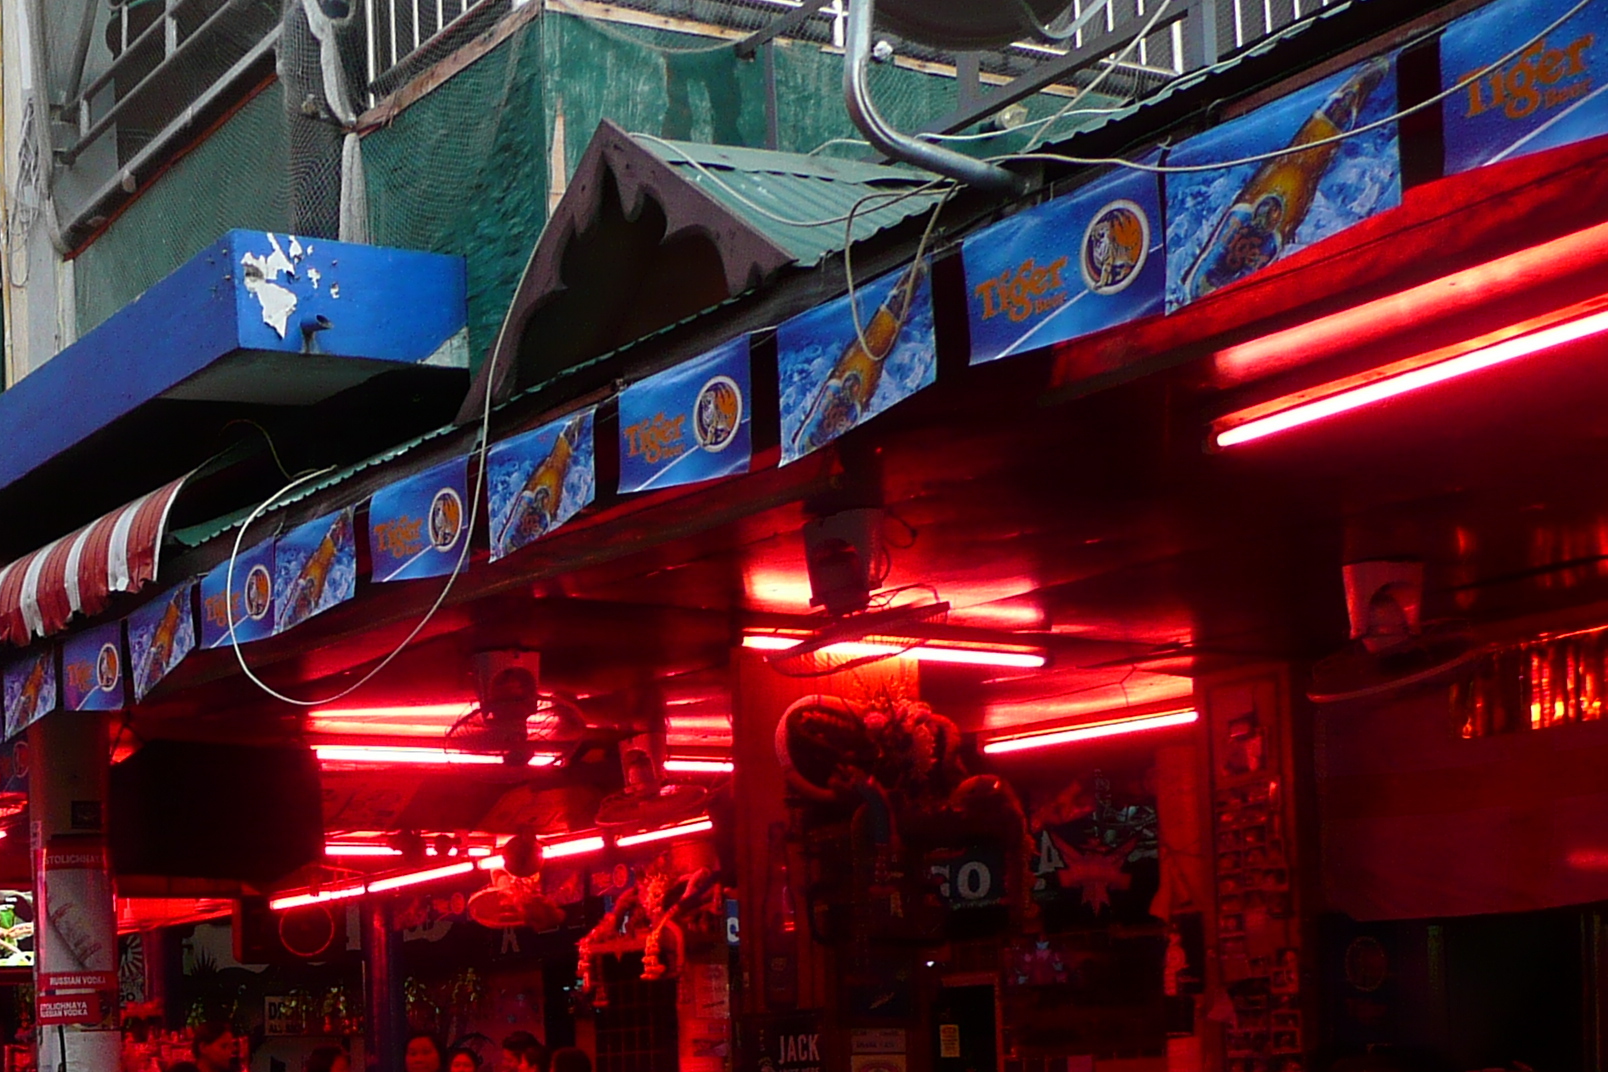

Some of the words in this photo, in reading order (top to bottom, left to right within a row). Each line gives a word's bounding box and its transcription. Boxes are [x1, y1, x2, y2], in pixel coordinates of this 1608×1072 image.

[1458, 33, 1595, 119] Tiger
[974, 255, 1069, 322] Tiger
[624, 411, 686, 464] Tiger
[374, 515, 423, 558] Tiger
[205, 590, 240, 627] Tigr
[778, 1034, 821, 1064] JACK
